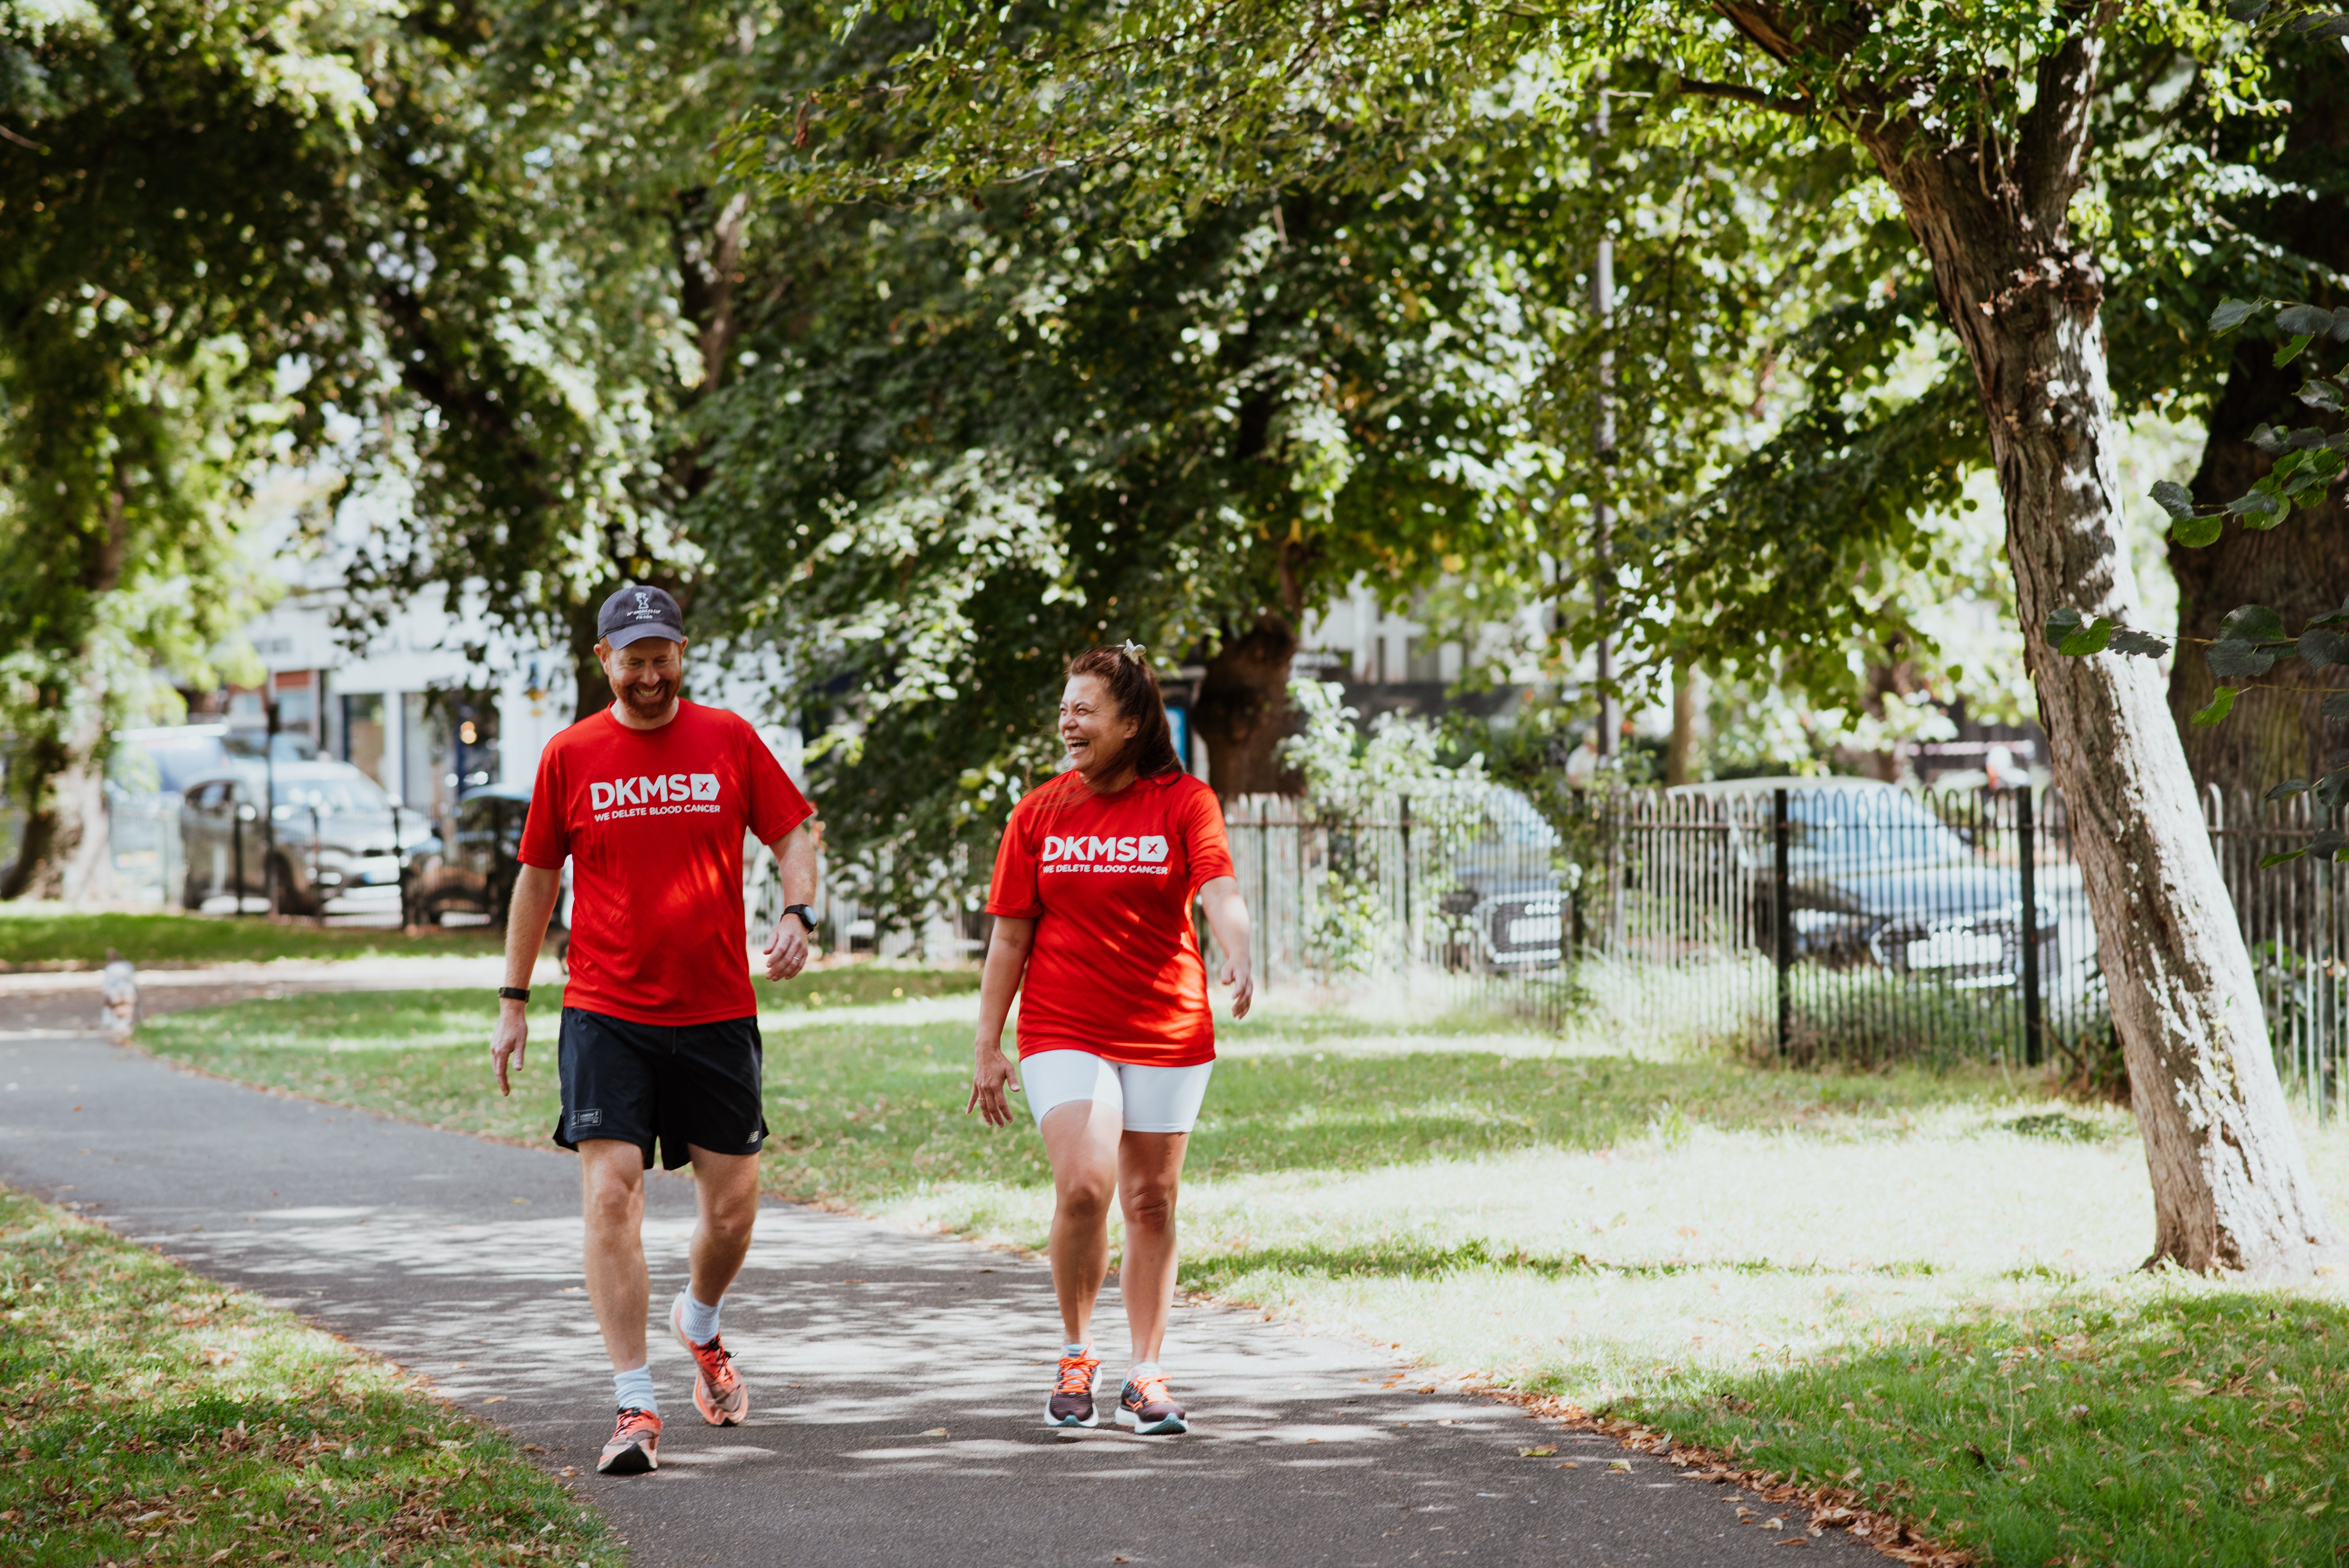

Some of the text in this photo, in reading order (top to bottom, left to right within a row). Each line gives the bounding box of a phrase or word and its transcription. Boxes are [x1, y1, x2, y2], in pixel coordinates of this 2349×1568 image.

[590, 774, 690, 810] DKMS
[594, 804, 720, 822] WE DELETE BLOOD CANCER
[1043, 836, 1138, 862] DKMS
[1042, 864, 1168, 875] WE DELETE BLOOD CANCER
